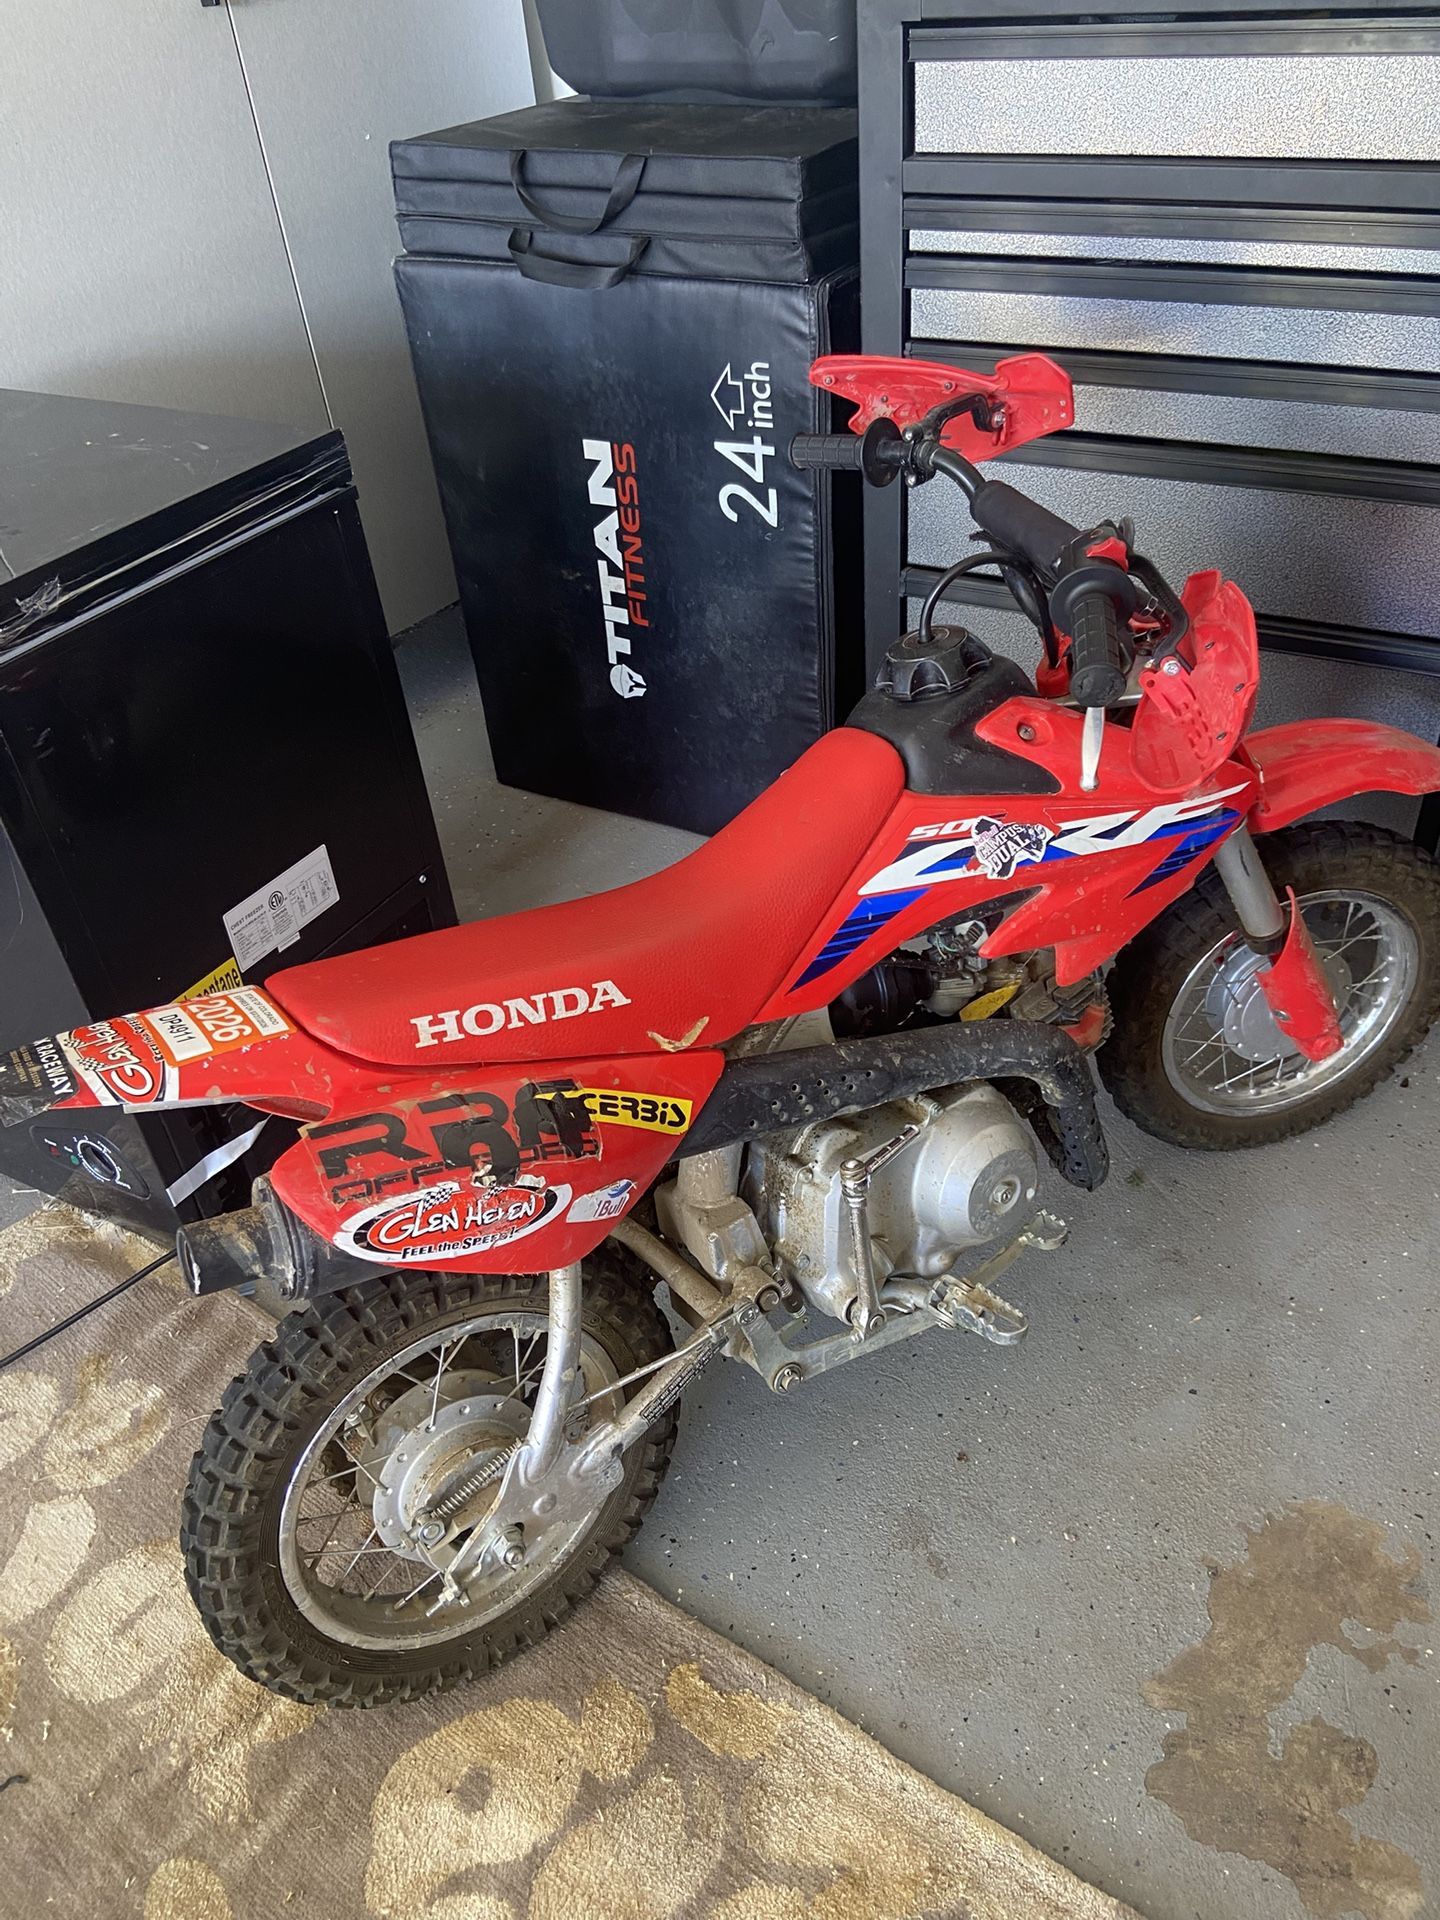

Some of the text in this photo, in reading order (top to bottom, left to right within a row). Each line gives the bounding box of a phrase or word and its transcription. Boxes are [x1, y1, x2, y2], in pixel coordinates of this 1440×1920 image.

[713, 361, 778, 528] 24 inch
[583, 438, 632, 664] TITAN
[613, 443, 649, 627] FITNESS
[858, 782, 1251, 895] CRF
[979, 824, 1025, 859] CAMPUS
[990, 835, 1030, 873] DUAL
[158, 1014, 197, 1043] DP4911
[186, 999, 253, 1042] 2026
[410, 980, 631, 1048] HONDA
[36, 1043, 74, 1095] RACEWAY
[97, 1041, 154, 1096] GLEN
[379, 1200, 460, 1245] GLEN
[402, 1244, 434, 1259] FEEL
[438, 1240, 460, 1251] the
